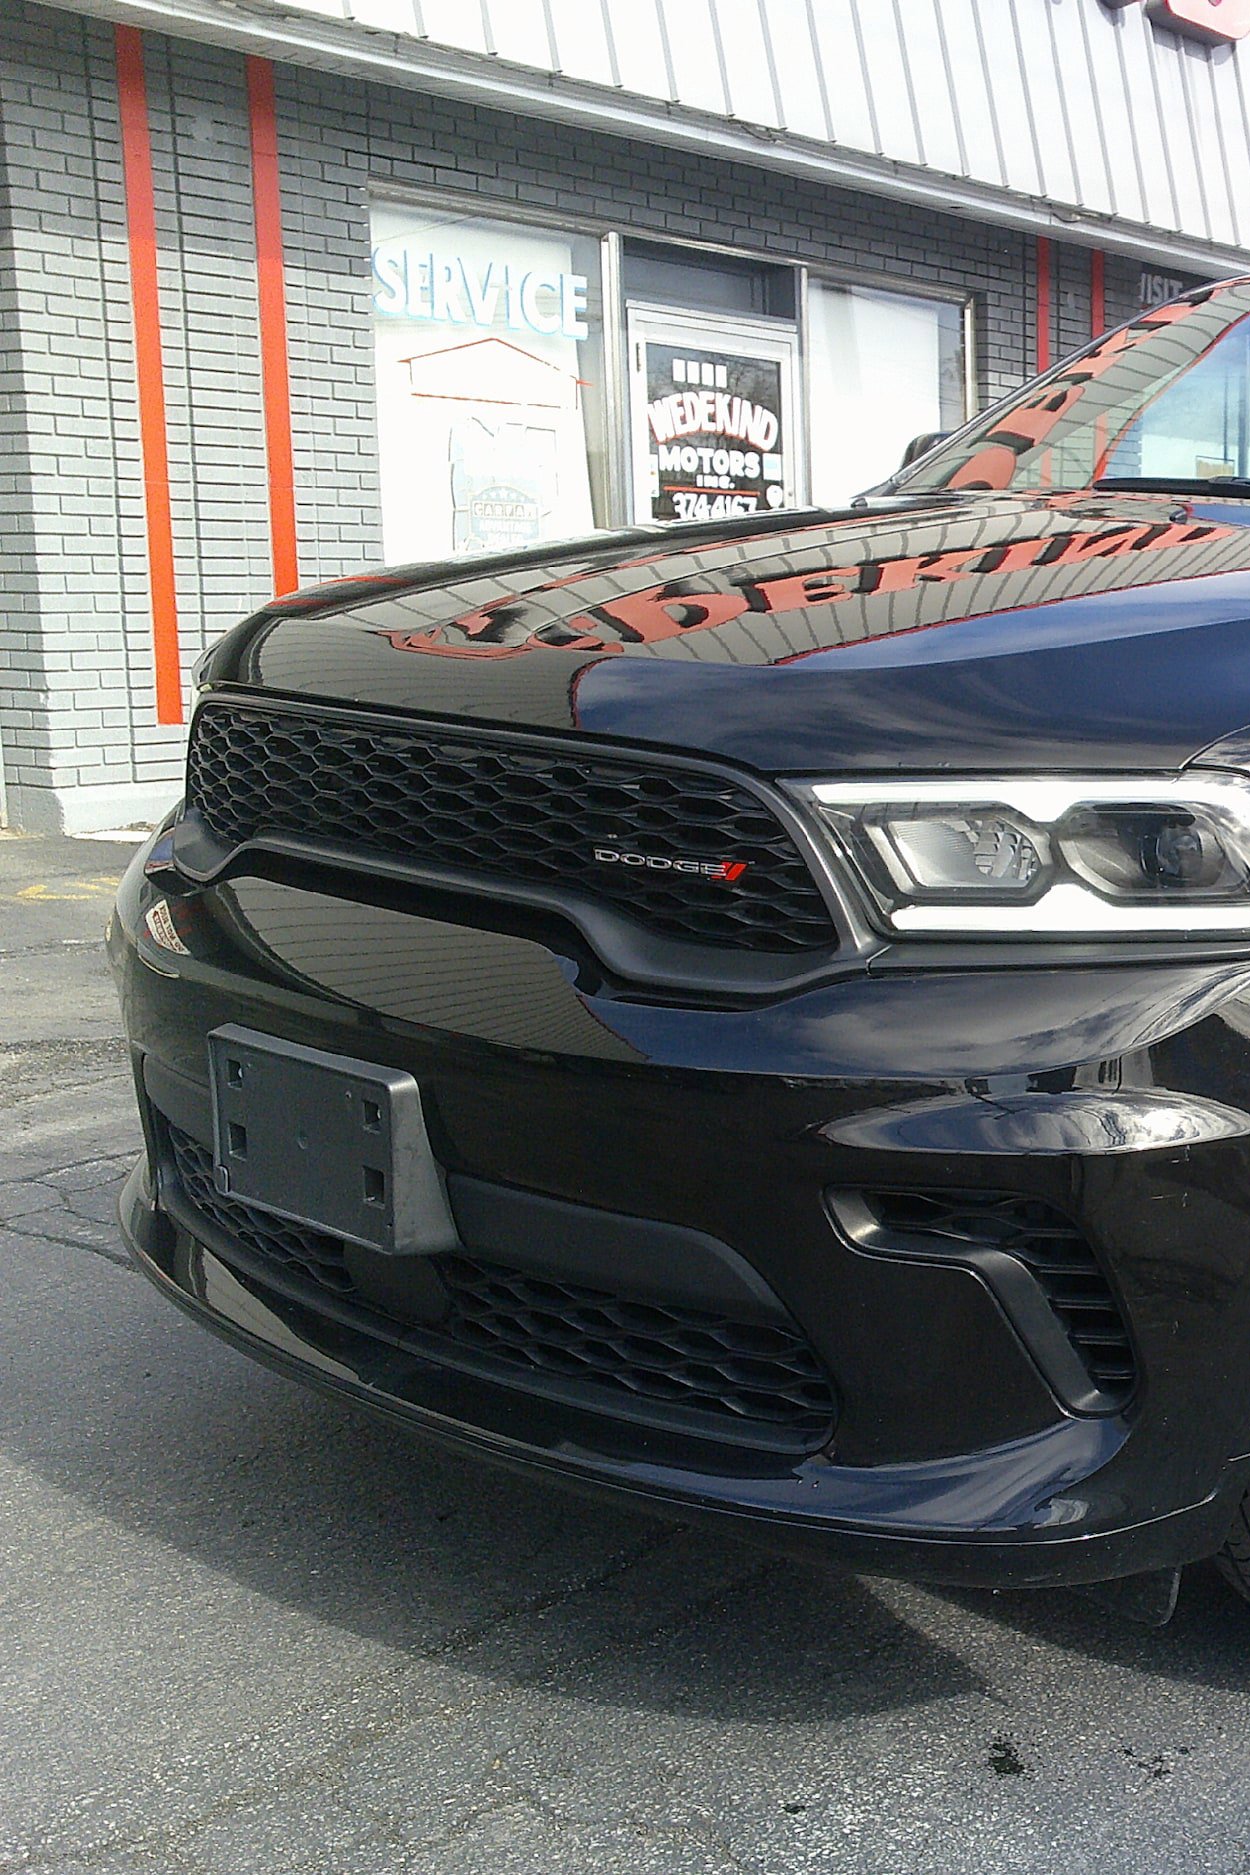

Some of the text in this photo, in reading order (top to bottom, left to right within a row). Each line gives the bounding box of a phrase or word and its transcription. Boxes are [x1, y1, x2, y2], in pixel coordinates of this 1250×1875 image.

[371, 246, 589, 340] SERVICE
[646, 390, 779, 451] WEDEKIND
[658, 445, 761, 478] MOTORS
[473, 502, 534, 518] CARFA
[594, 848, 727, 878] DODGE
